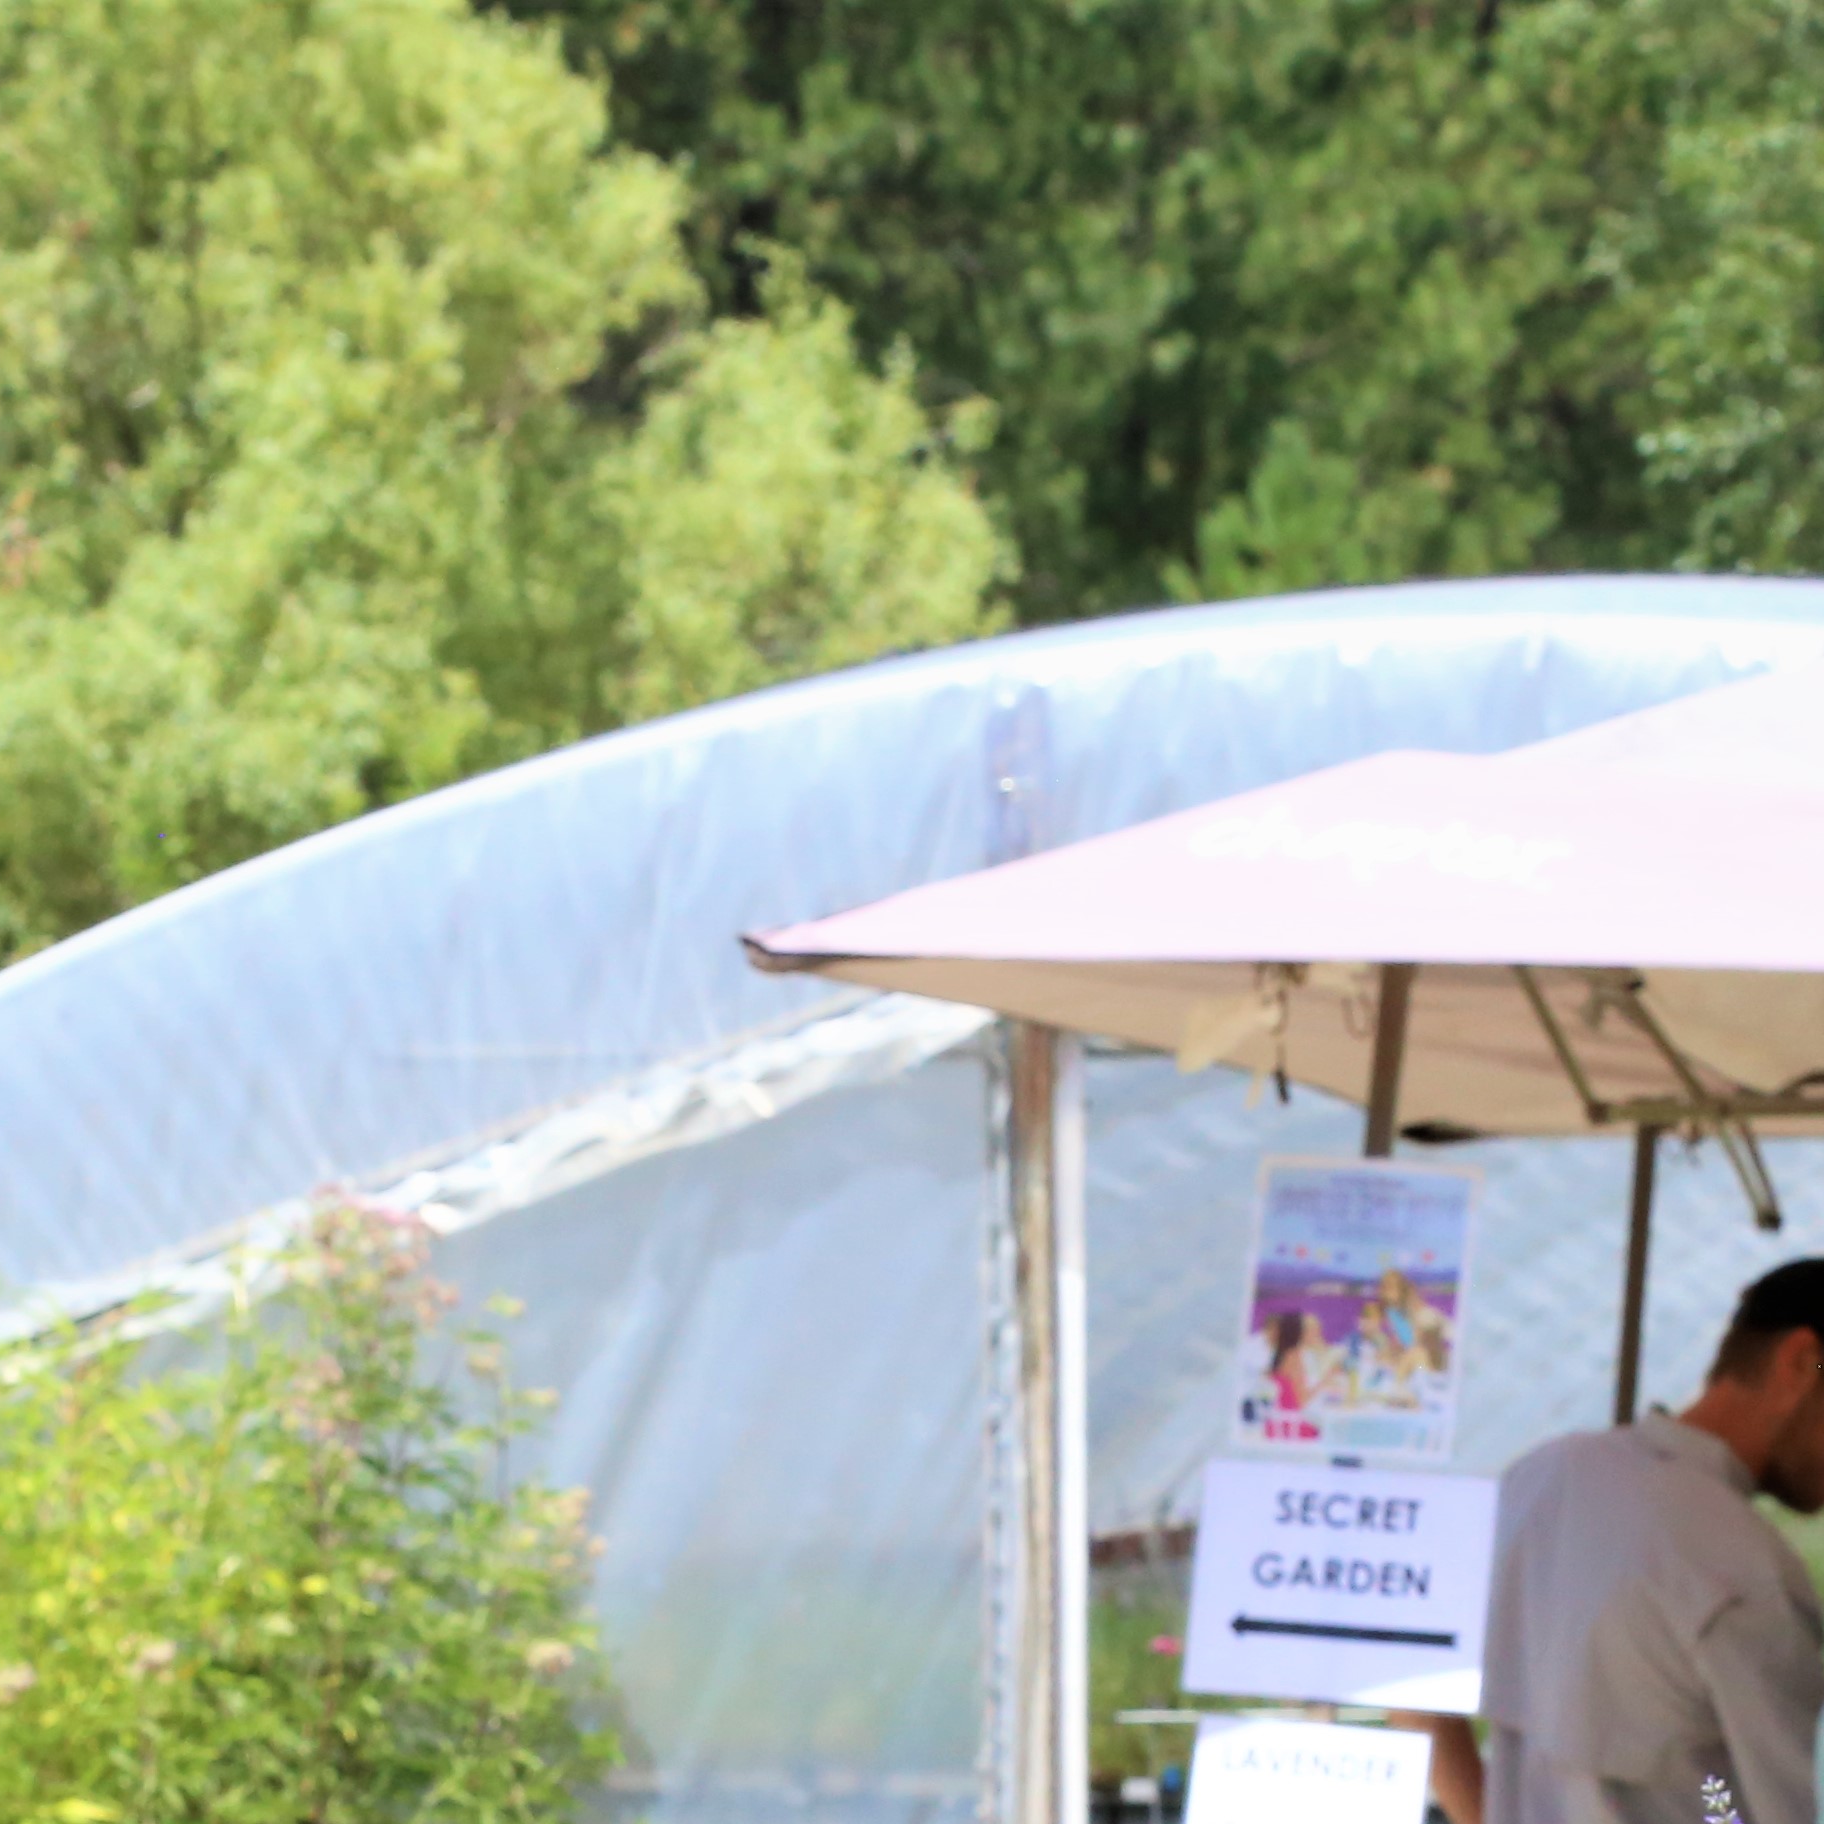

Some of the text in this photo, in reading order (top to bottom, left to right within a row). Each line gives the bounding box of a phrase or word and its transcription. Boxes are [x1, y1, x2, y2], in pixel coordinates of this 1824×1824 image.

[1274, 1489, 1423, 1532] SECRET
[1251, 1551, 1432, 1598] GARDEN
[1221, 1739, 1402, 1785] LAVENDER
